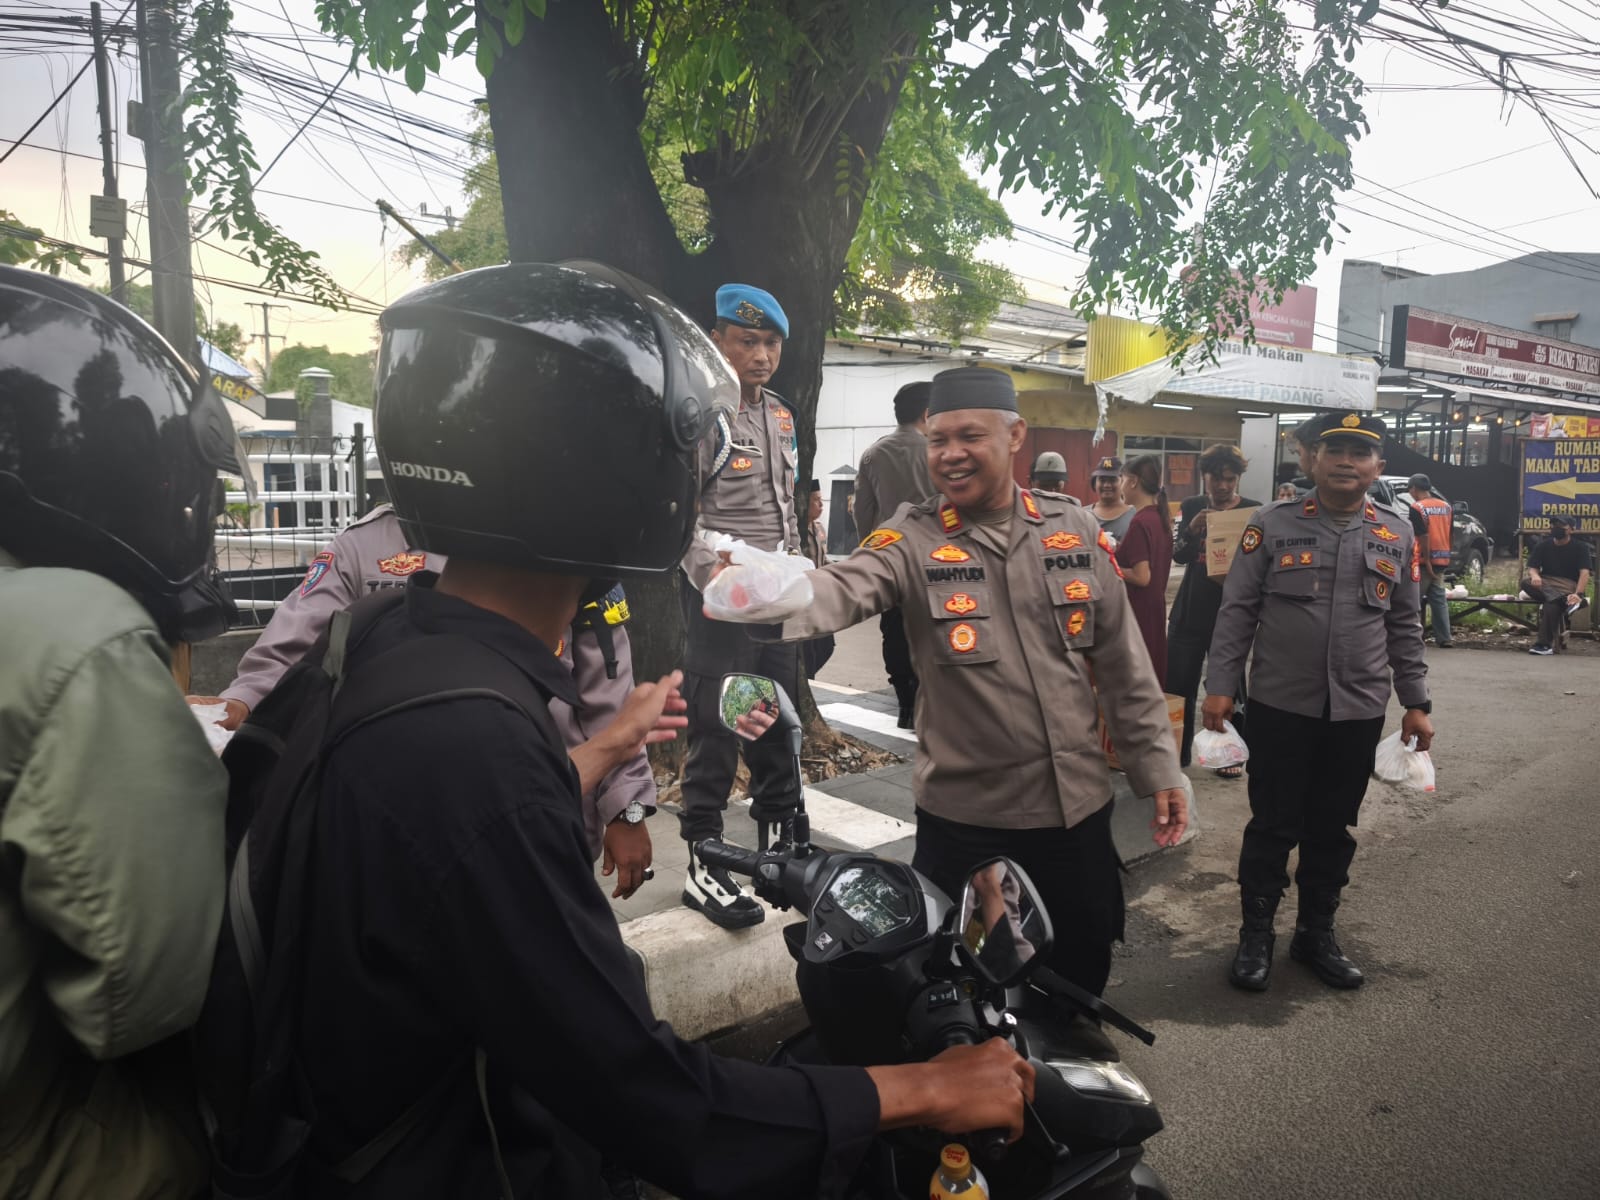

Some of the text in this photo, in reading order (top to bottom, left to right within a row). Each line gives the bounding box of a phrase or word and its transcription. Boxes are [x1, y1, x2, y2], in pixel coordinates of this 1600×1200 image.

[1257, 345, 1303, 363] Makan
[1260, 386, 1323, 404] PADANG
[1555, 441, 1600, 456] RUMAH
[390, 461, 474, 487] HONDA
[1525, 458, 1570, 473] MAKAN
[1368, 541, 1402, 559] POLRI
[1044, 554, 1091, 570] POLRI
[925, 567, 985, 582] WAHYUDI
